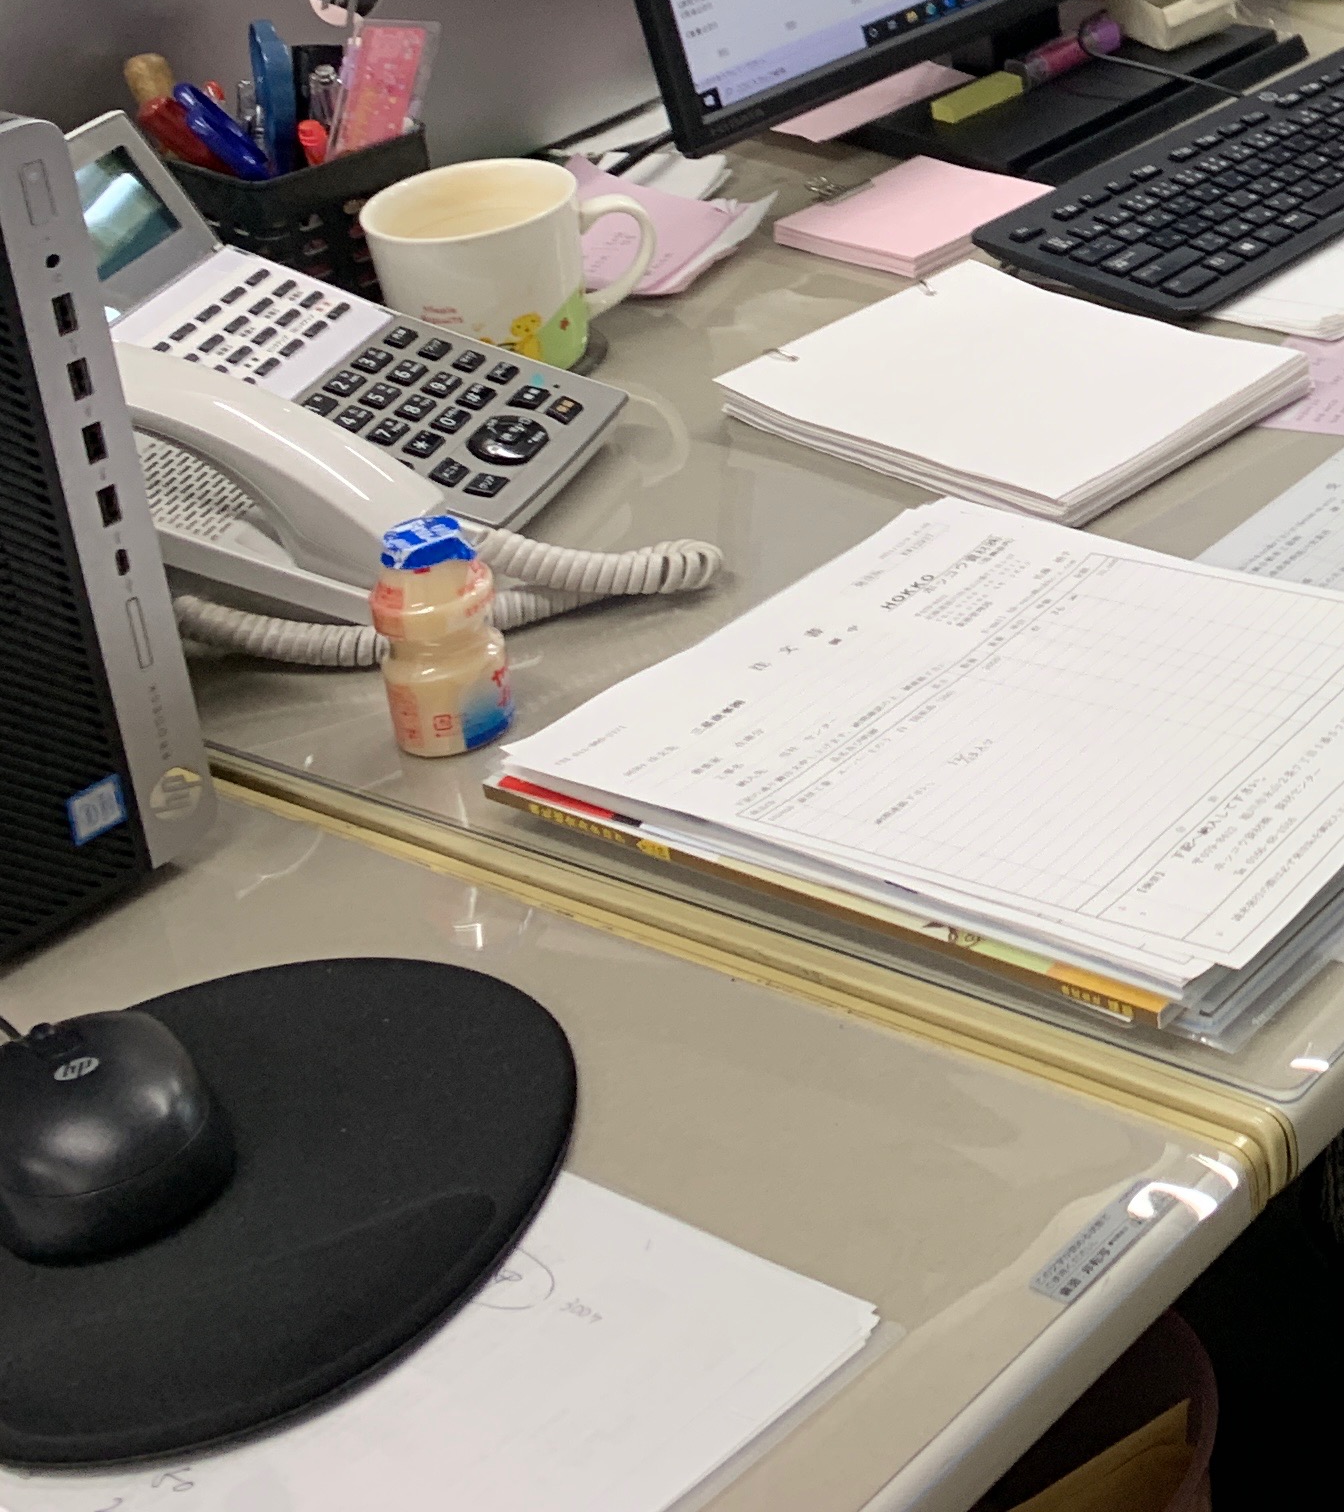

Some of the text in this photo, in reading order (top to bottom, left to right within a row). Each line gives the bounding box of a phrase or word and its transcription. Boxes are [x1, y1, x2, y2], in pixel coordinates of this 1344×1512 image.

[364, 357, 377, 368] 3
[337, 369, 412, 391] 2 6
[374, 392, 386, 402] 5
[436, 381, 448, 392] 9
[342, 403, 458, 427] 4 8 0
[382, 427, 394, 438] 7
[877, 573, 939, 610] HOKKO
